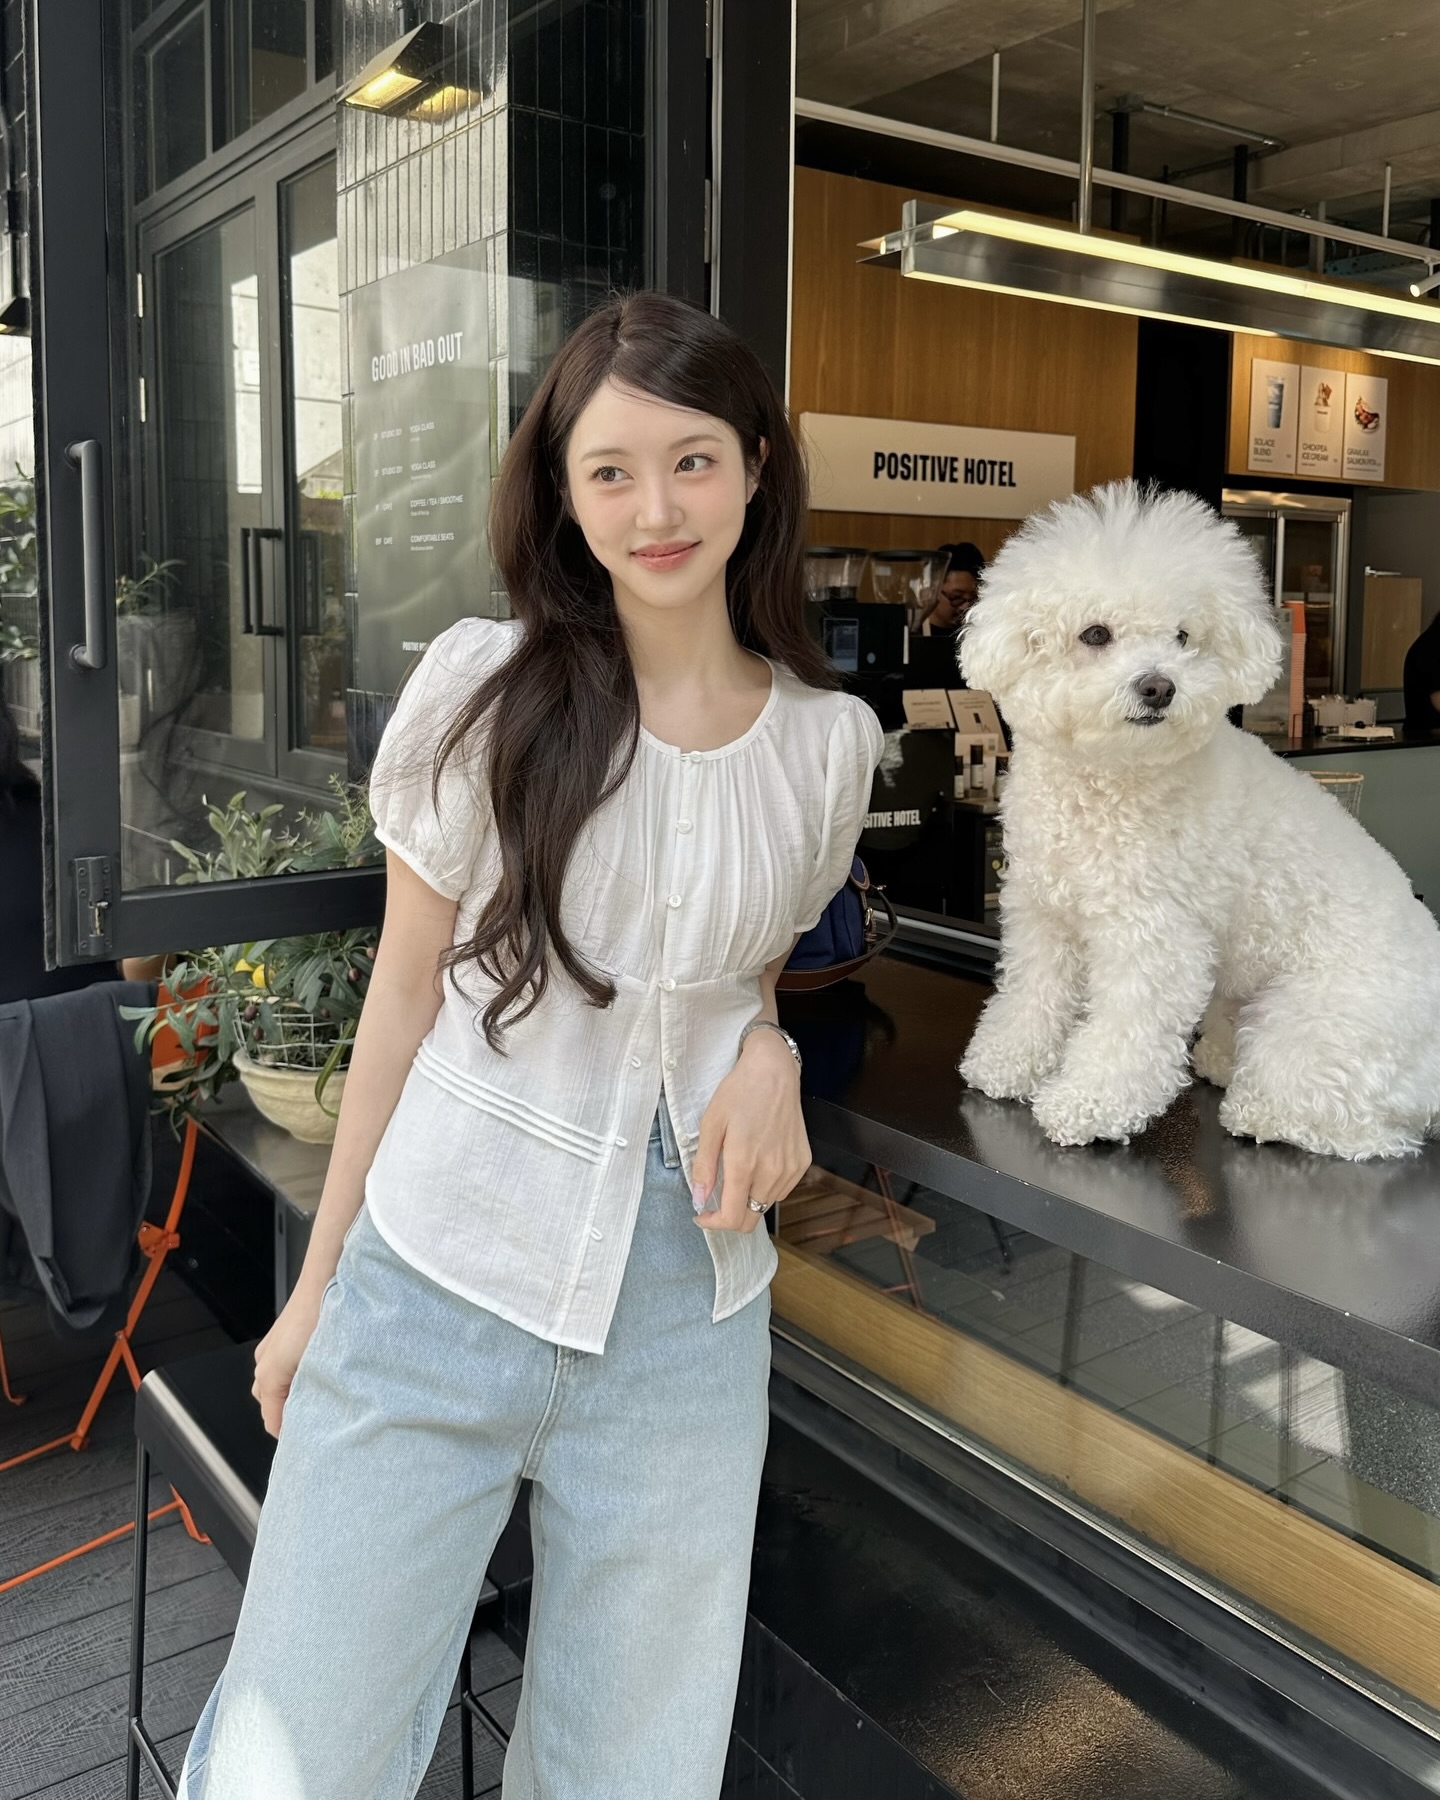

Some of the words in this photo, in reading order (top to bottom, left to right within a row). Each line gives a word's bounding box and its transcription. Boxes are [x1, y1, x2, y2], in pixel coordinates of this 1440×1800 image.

[372, 351, 399, 382] GOOD
[400, 346, 411, 375] IN
[412, 339, 435, 371] BAD
[438, 331, 463, 364] OUT
[421, 422, 435, 431] CLASS
[411, 463, 421, 471] YOGA
[422, 461, 436, 470] CLASS
[873, 451, 959, 484] POSITIVE
[963, 457, 1016, 488] HOTEL
[410, 499, 426, 508] COFFEE
[429, 497, 437, 506] TEA
[440, 494, 464, 505] SMOOTHIE
[410, 534, 440, 543] COMFORTABLE
[440, 532, 455, 541] SEATS
[893, 809, 921, 827] HOTEL
